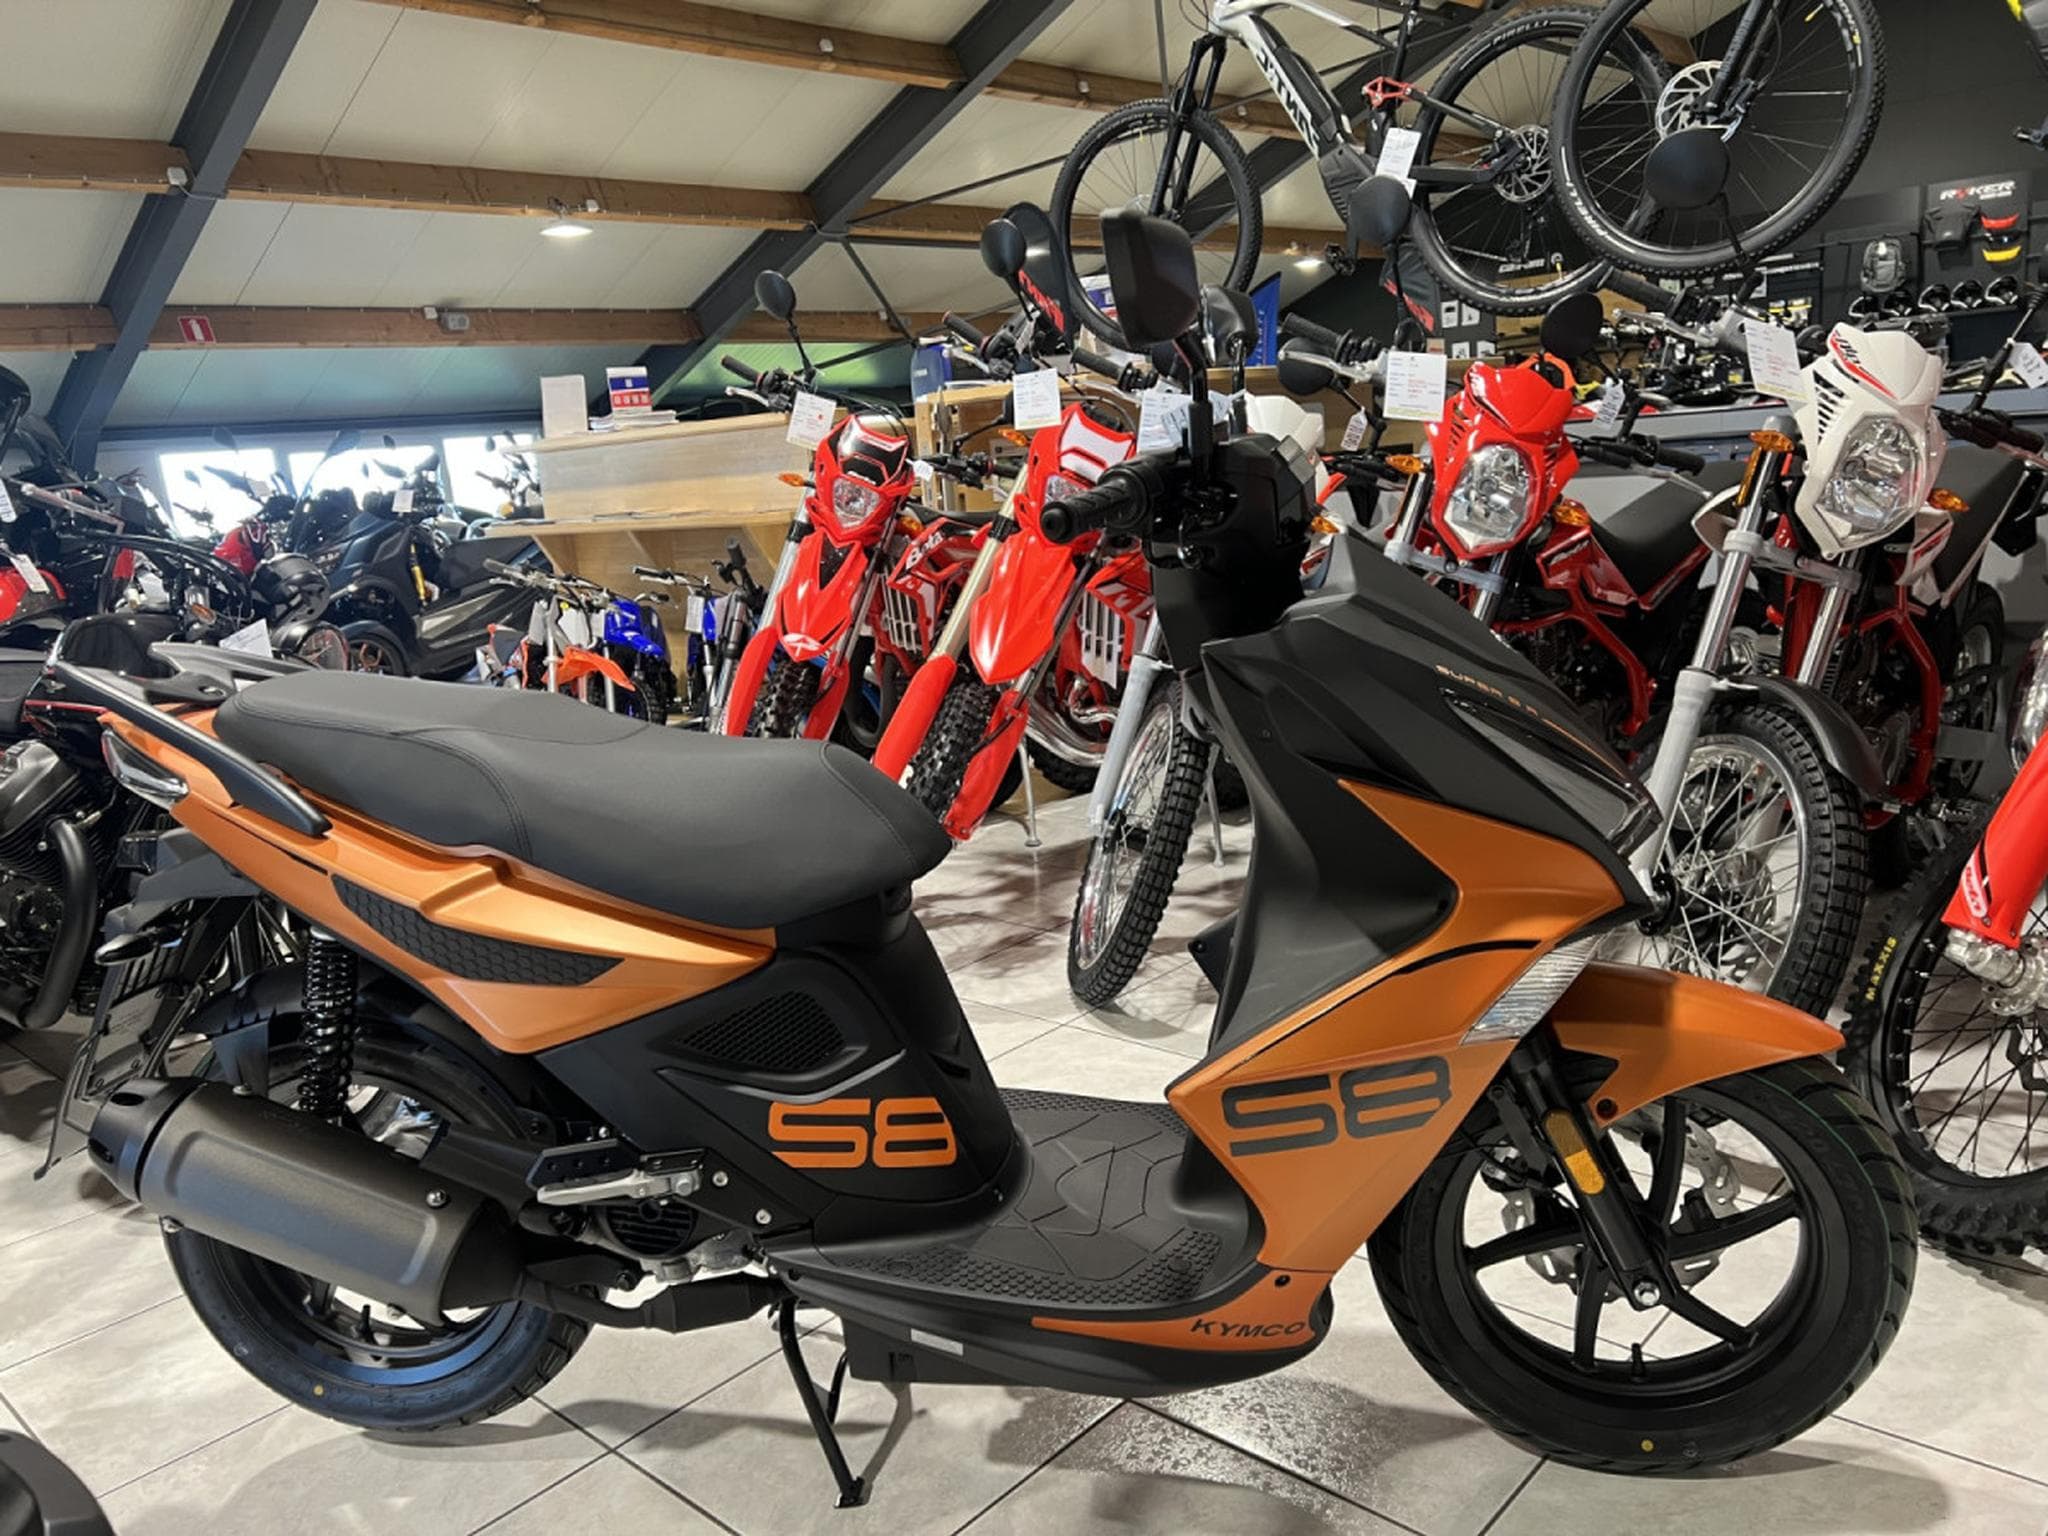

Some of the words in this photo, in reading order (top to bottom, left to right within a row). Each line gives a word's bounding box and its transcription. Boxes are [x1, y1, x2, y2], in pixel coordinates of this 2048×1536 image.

[1492, 19, 1549, 46] PIRELLI
[1864, 936, 1897, 1001] MAXXIS
[768, 1096, 958, 1168] S8
[1221, 1055, 1453, 1158] S8
[1190, 1318, 1307, 1338] KYMCO
